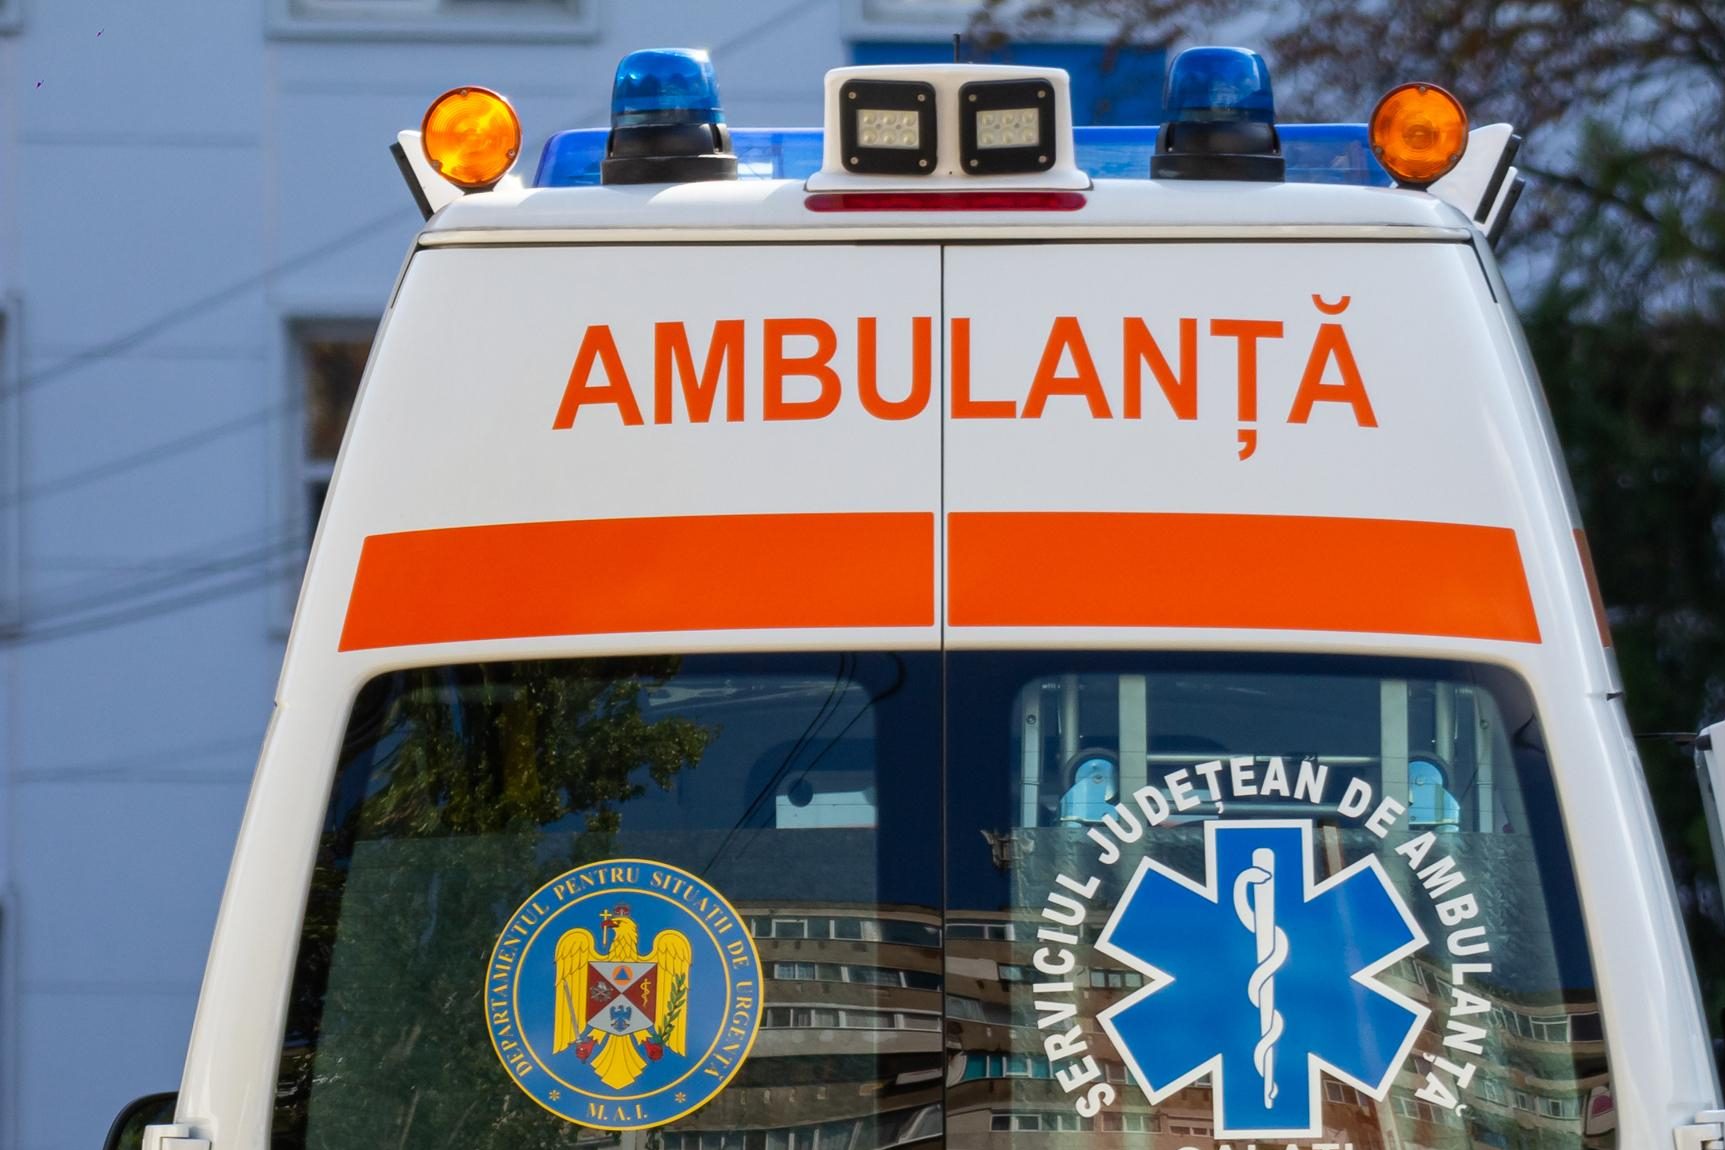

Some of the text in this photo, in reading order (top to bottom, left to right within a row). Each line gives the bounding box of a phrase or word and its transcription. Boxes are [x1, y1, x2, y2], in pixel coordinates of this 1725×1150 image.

[552, 294, 1379, 462] AMBULANȚĂ
[491, 867, 753, 1081] DEPARTAMENTUL PENTRU SITUAȚII DE URGENȚĂ
[1032, 757, 1493, 1118] SERVICIUL JUDEȚEAN DE AMBULANȚĂ
